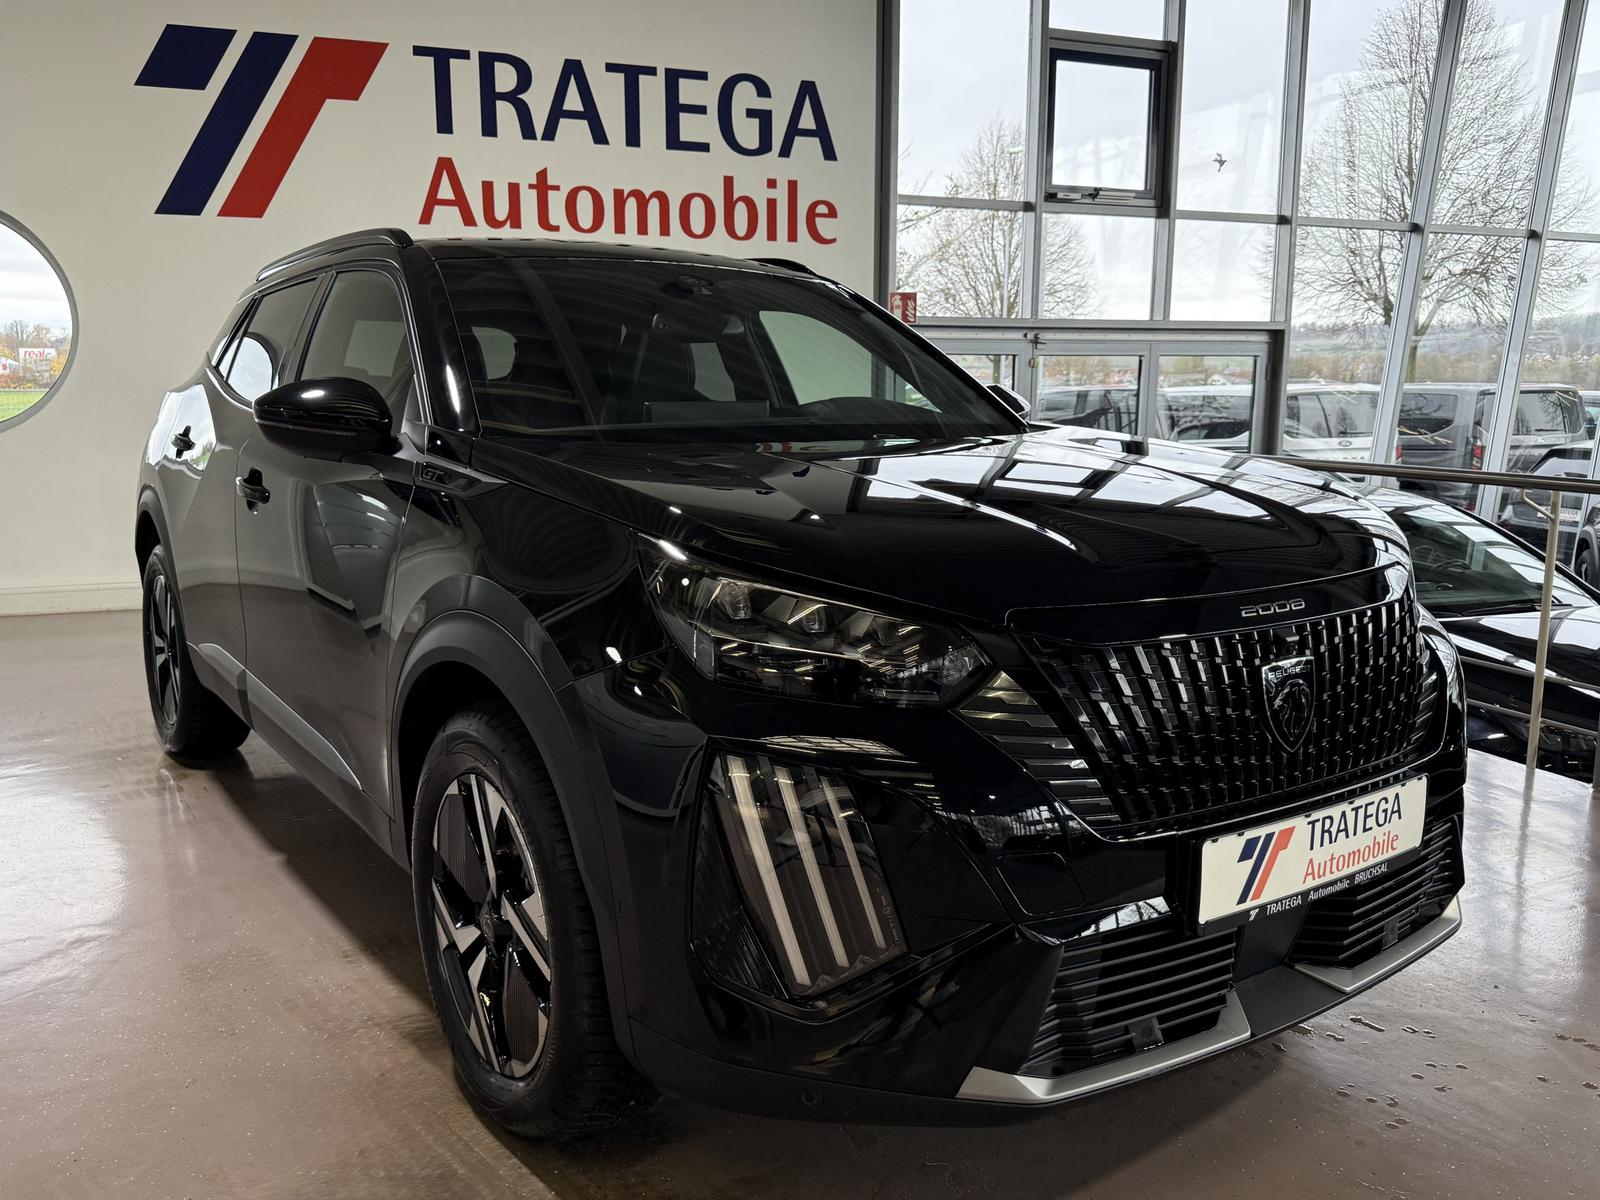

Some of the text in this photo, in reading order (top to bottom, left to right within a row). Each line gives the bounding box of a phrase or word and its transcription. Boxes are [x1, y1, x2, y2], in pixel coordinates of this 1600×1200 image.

[412, 44, 838, 162] TRATEGA
[418, 156, 839, 245] Automobile
[422, 468, 445, 481] GT
[1240, 598, 1305, 617] 2008
[1268, 665, 1311, 681] PEUGEOT
[1306, 792, 1402, 851] TRATEGA
[1302, 830, 1399, 885] Automobile
[1266, 862, 1389, 916] TRATEGA Automobile BRUCHSAL
